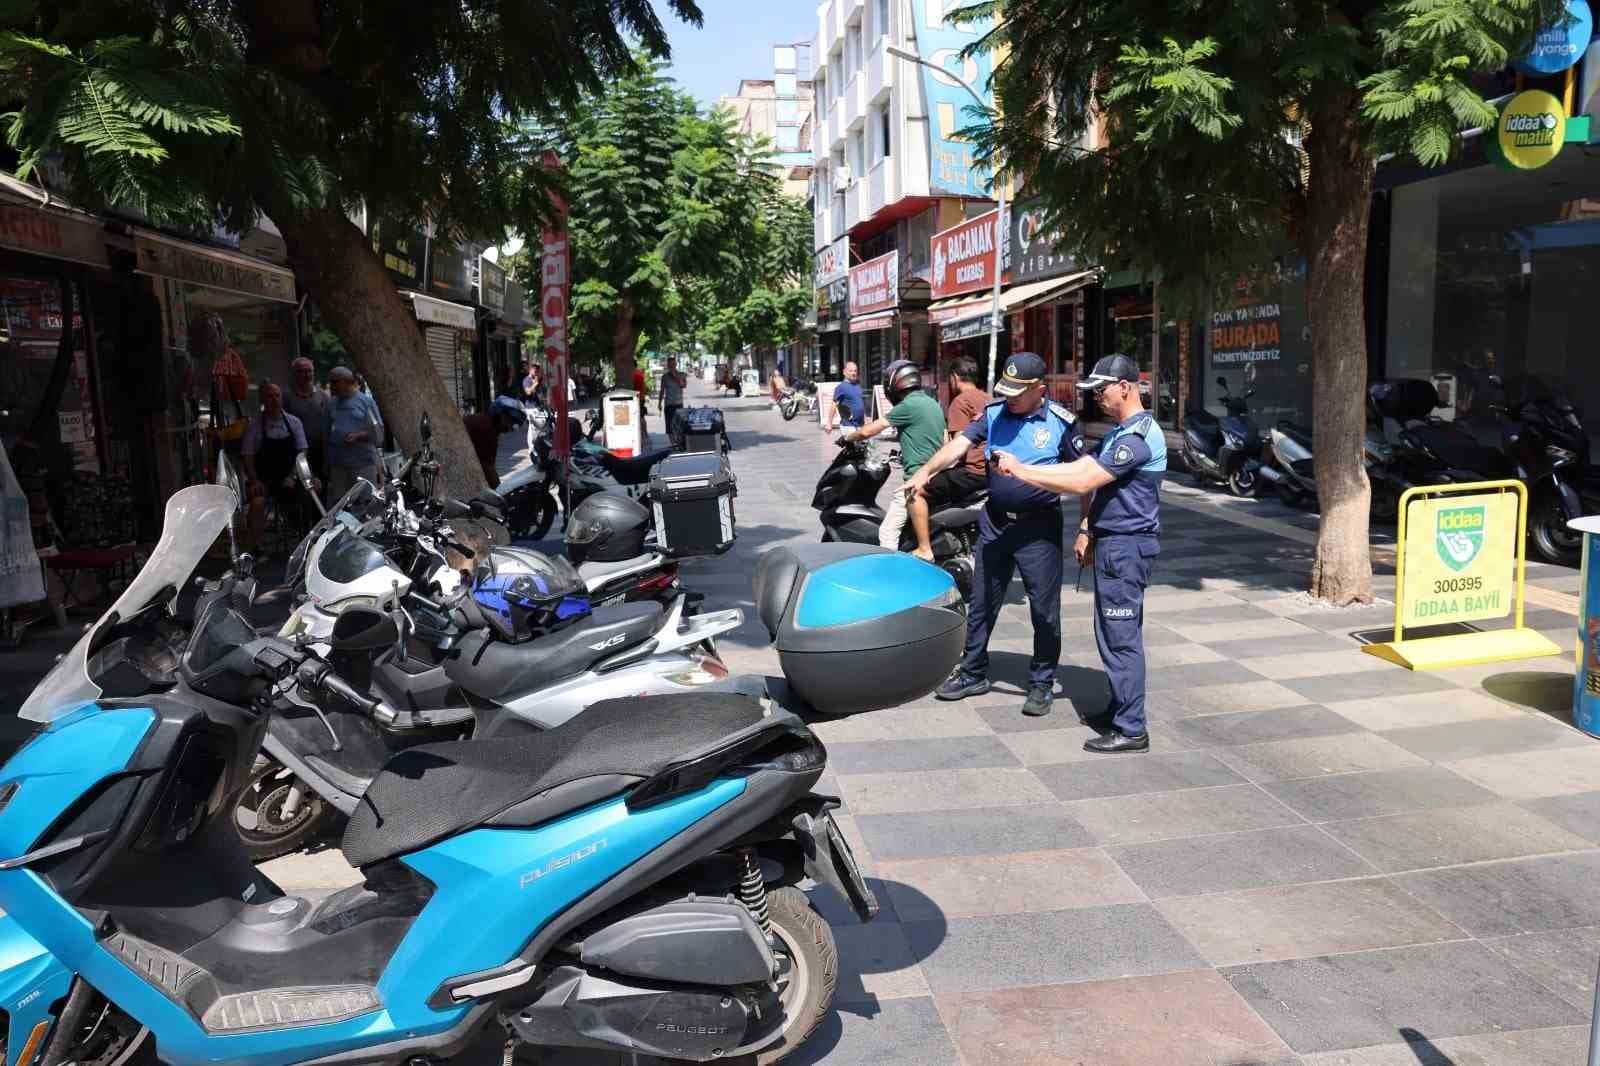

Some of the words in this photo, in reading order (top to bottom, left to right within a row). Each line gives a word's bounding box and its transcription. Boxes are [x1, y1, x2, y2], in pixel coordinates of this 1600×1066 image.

[1506, 116, 1540, 130] iddaa
[1516, 129, 1554, 146] matik
[948, 221, 993, 264] BACANAK
[1212, 321, 1280, 348] BURADA
[1439, 511, 1482, 531] iddaa
[1433, 577, 1482, 594] 300395
[1105, 608, 1135, 617] ZABITA
[1414, 598, 1459, 618] İDDAA
[656, 1023, 729, 1035] PEUGEOT
